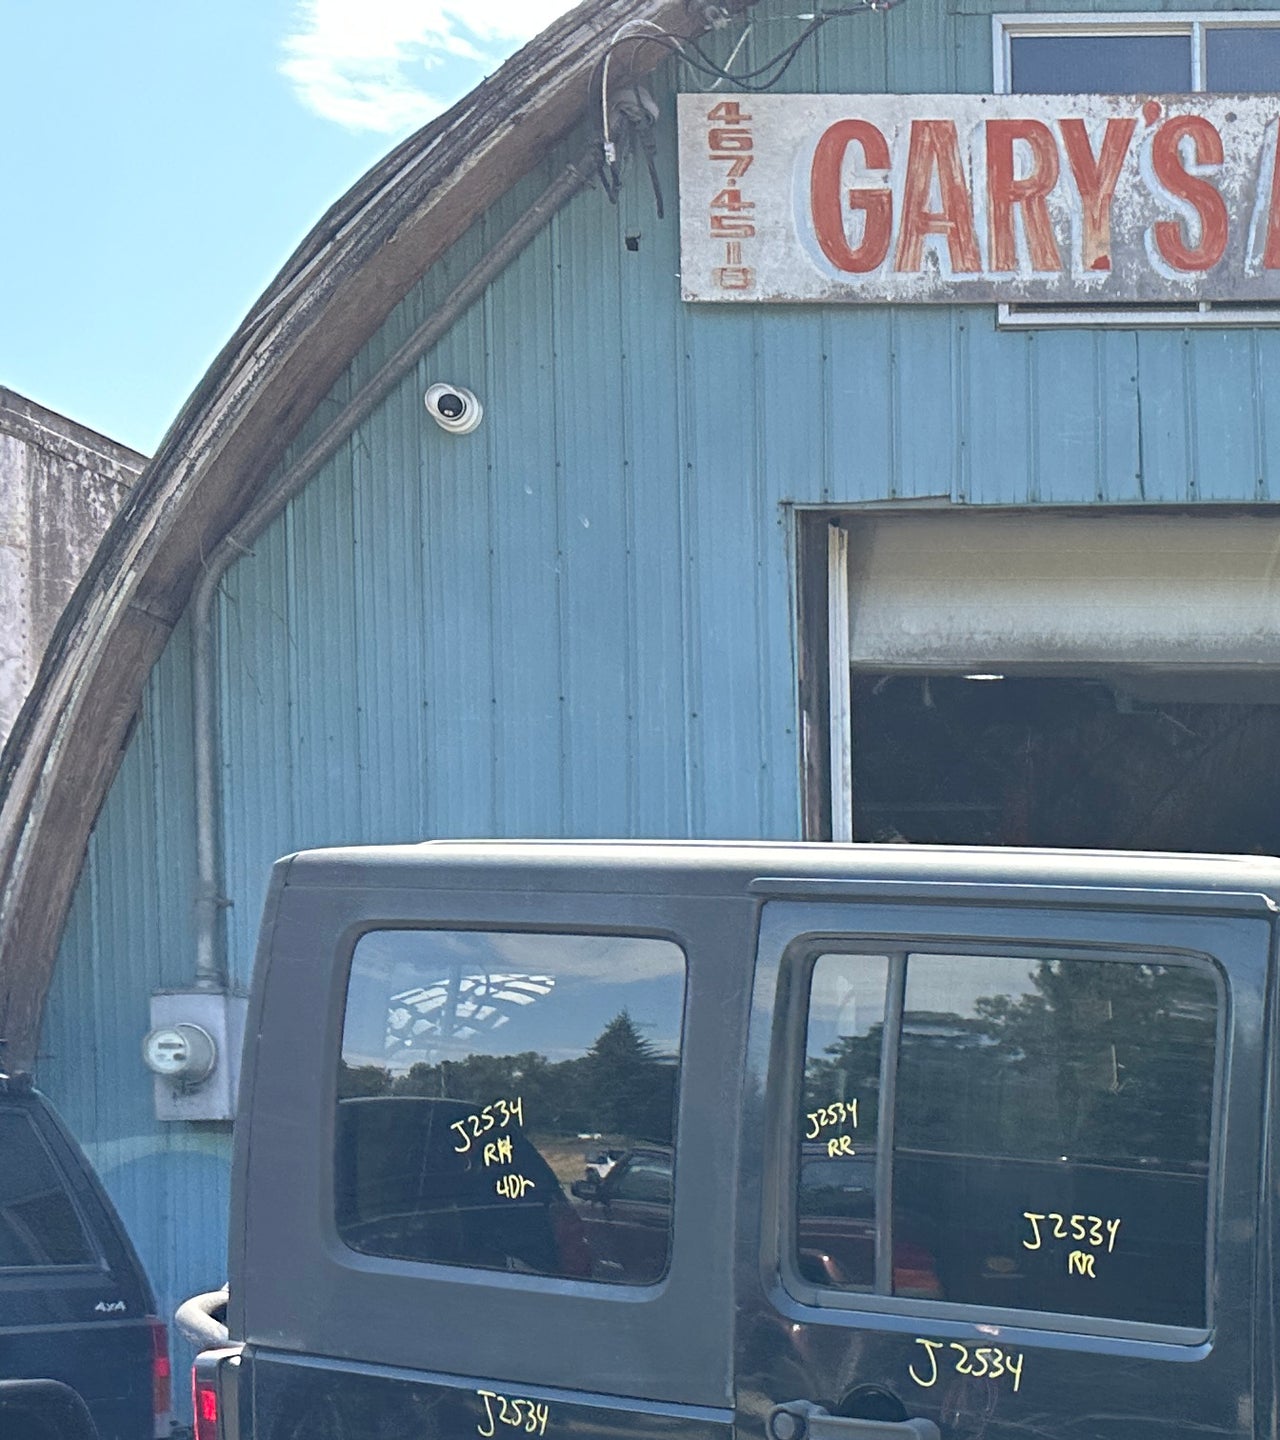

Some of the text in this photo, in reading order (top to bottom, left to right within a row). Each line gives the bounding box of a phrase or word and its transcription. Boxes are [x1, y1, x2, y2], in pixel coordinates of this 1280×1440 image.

[810, 99, 1229, 274] GARY'S
[449, 1096, 524, 1154] J2534
[806, 1098, 858, 1140] J2534
[1022, 1211, 1122, 1254] J2534
[908, 1338, 1024, 1392] J2534
[476, 1389, 550, 1437] J2534
